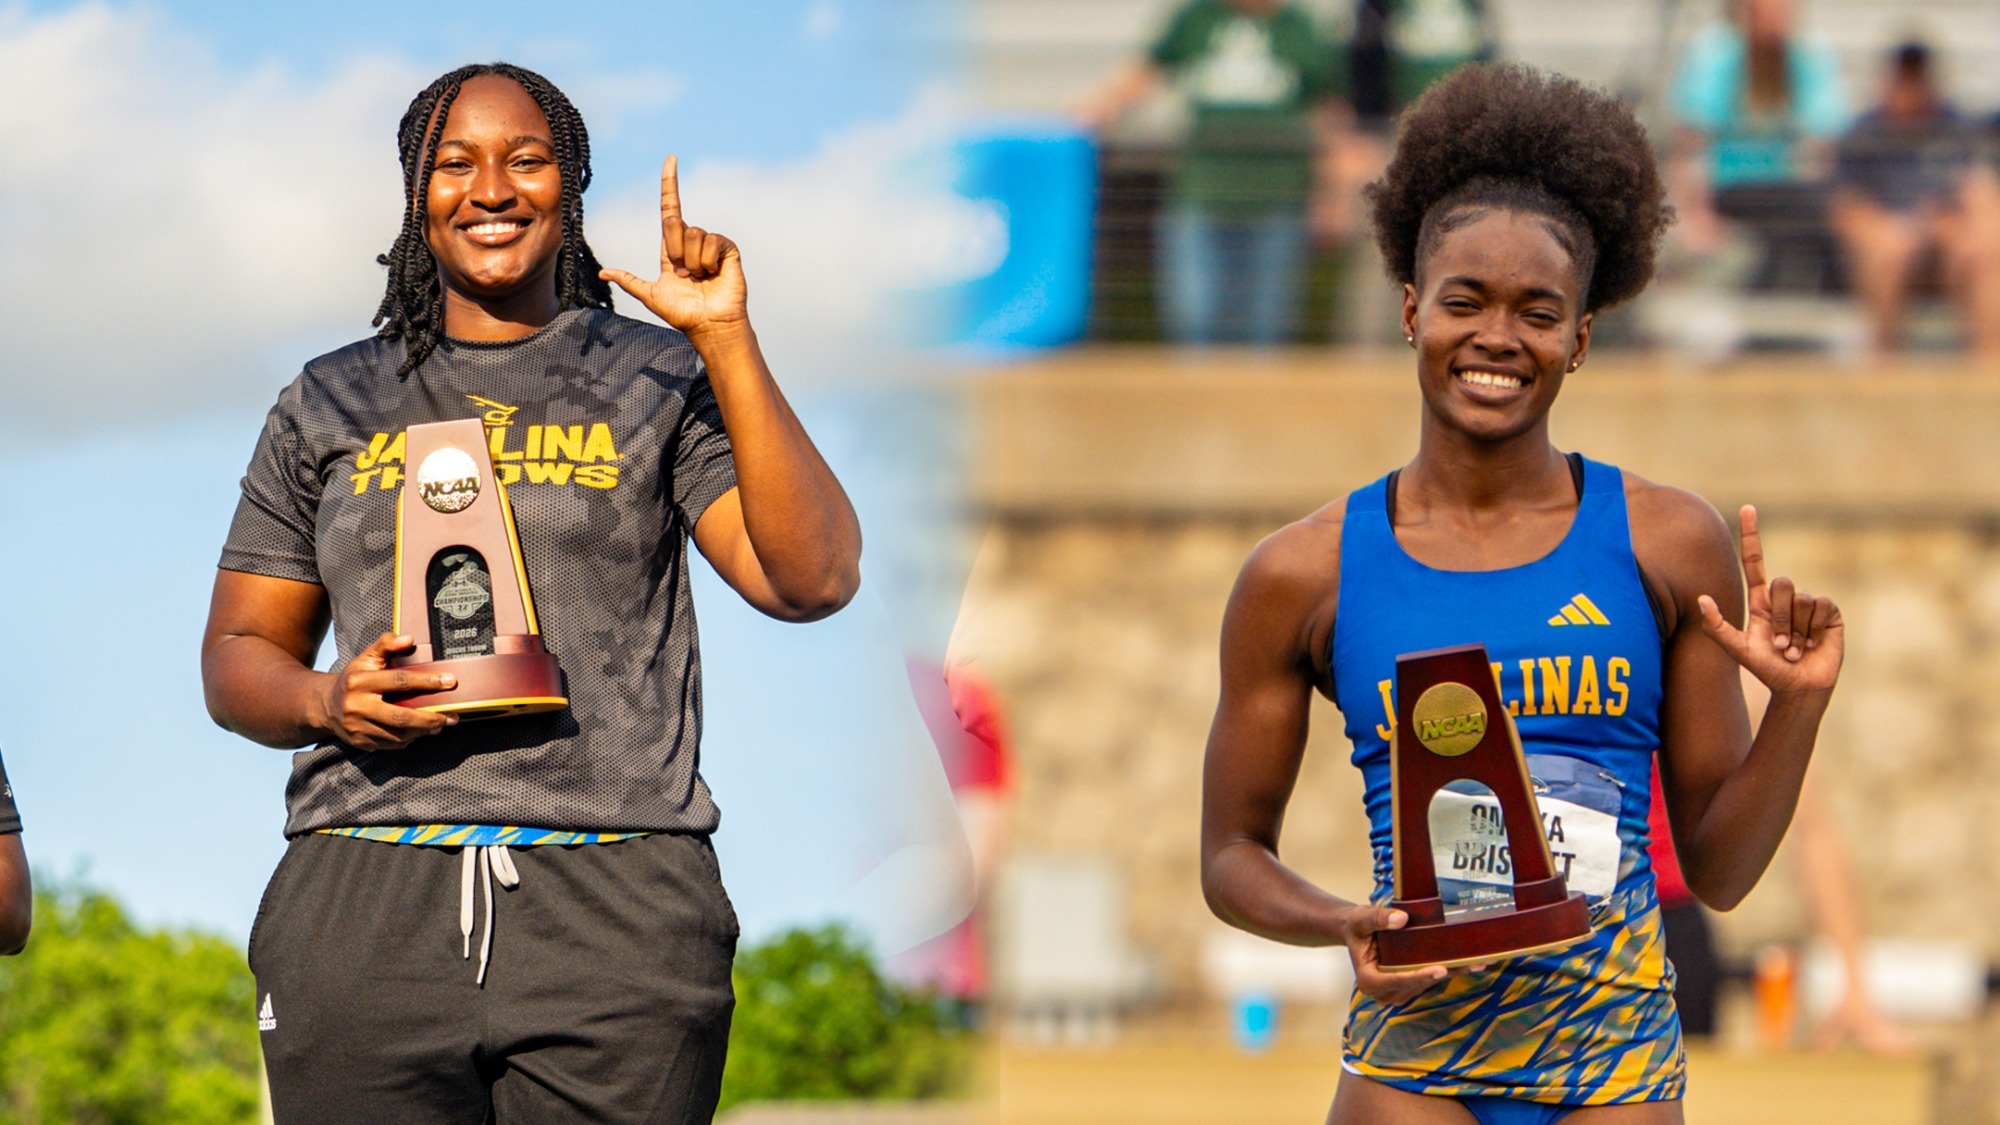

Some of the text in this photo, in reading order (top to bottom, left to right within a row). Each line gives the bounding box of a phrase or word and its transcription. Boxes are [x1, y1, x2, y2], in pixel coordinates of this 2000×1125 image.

[356, 423, 618, 470] JALINA
[350, 462, 619, 496] THOWS
[423, 477, 479, 500] NCAA
[454, 627, 477, 639] 2026
[1376, 655, 1631, 741] JLINAS
[1421, 712, 1484, 741] NCAA
